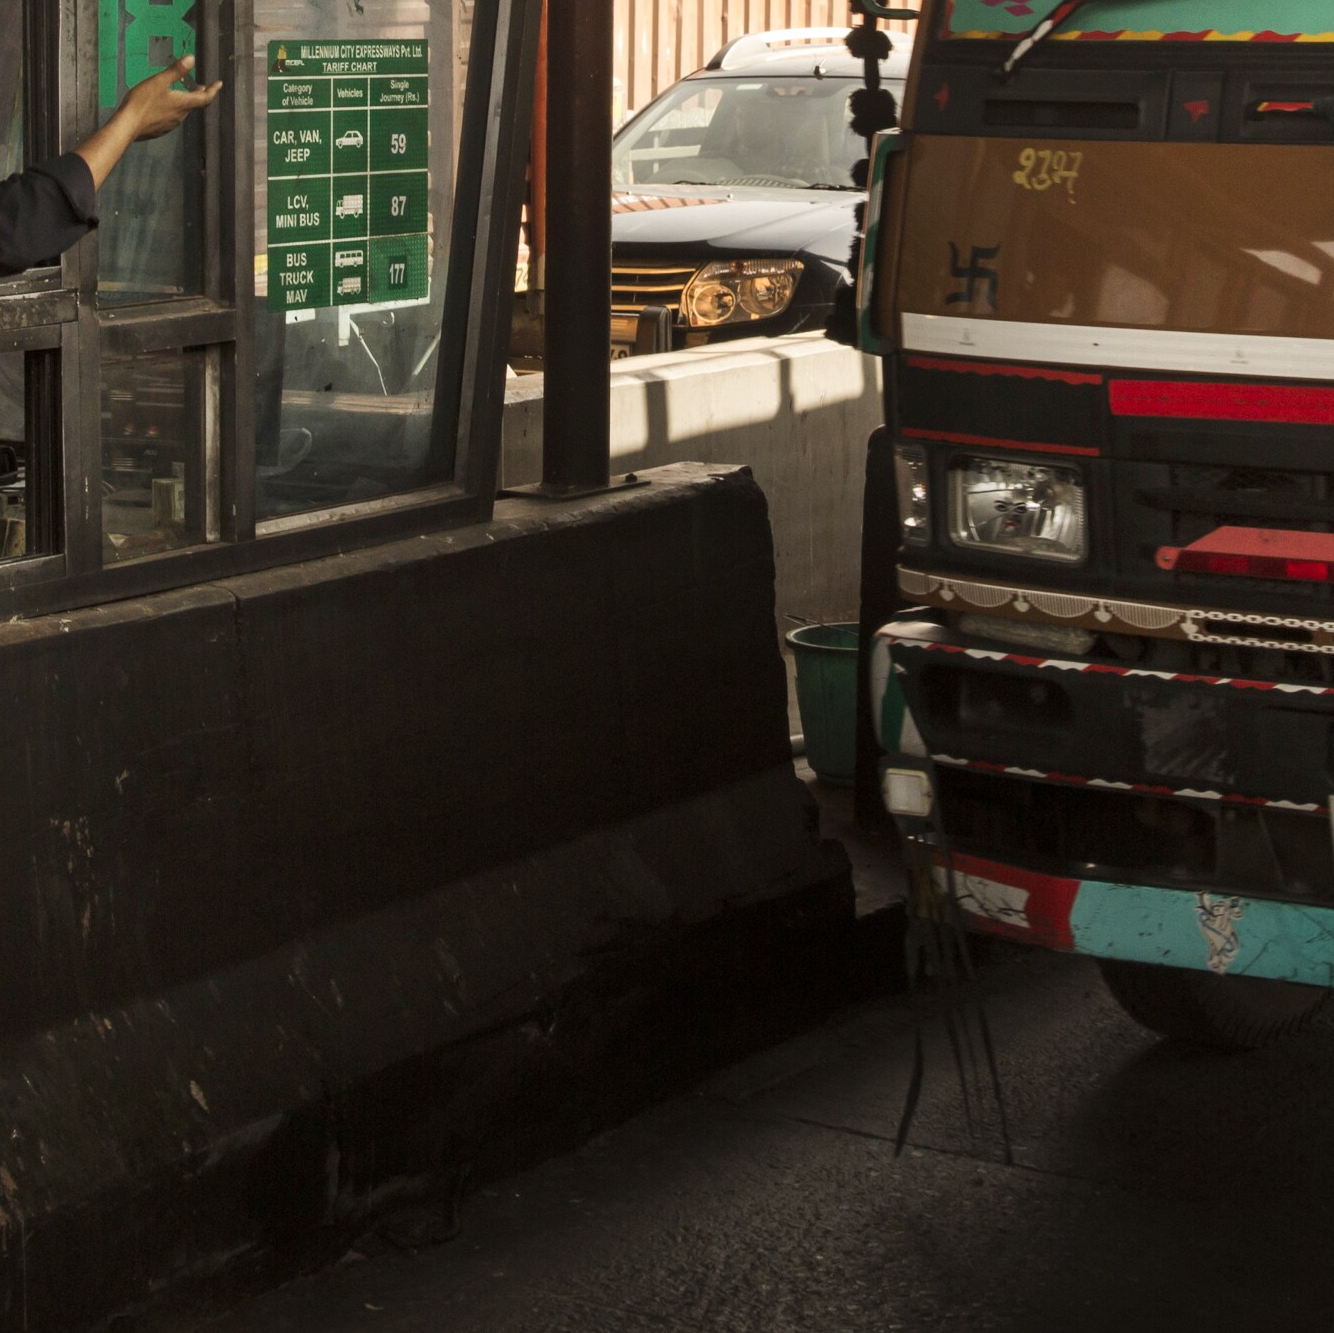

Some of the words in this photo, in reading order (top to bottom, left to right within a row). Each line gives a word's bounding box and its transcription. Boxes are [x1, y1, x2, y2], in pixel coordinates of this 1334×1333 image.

[301, 45, 340, 59] MILLENNIUM
[340, 44, 354, 58] CITY
[355, 44, 400, 58] EXPRESSWAYS
[322, 62, 349, 72] TARIFF
[351, 61, 378, 72] CHART
[283, 83, 313, 94] Category
[390, 79, 410, 91] Single
[336, 88, 363, 98] Vehicles
[379, 93, 404, 104] Journey
[405, 91, 420, 104] (Rs.)
[282, 97, 289, 106] of
[290, 96, 314, 106] Vehicle
[273, 131, 297, 146] CAR,
[299, 129, 322, 145] VAN,
[390, 133, 407, 154] 59
[285, 148, 310, 163] JEEP
[287, 195, 309, 210] LCV,
[390, 196, 407, 216] 87
[275, 214, 297, 228] MINI
[299, 212, 320, 226] BUS
[286, 252, 307, 267] BUS
[279, 270, 314, 286] TRUCK
[389, 263, 405, 284] 177
[286, 289, 307, 304] MAV
